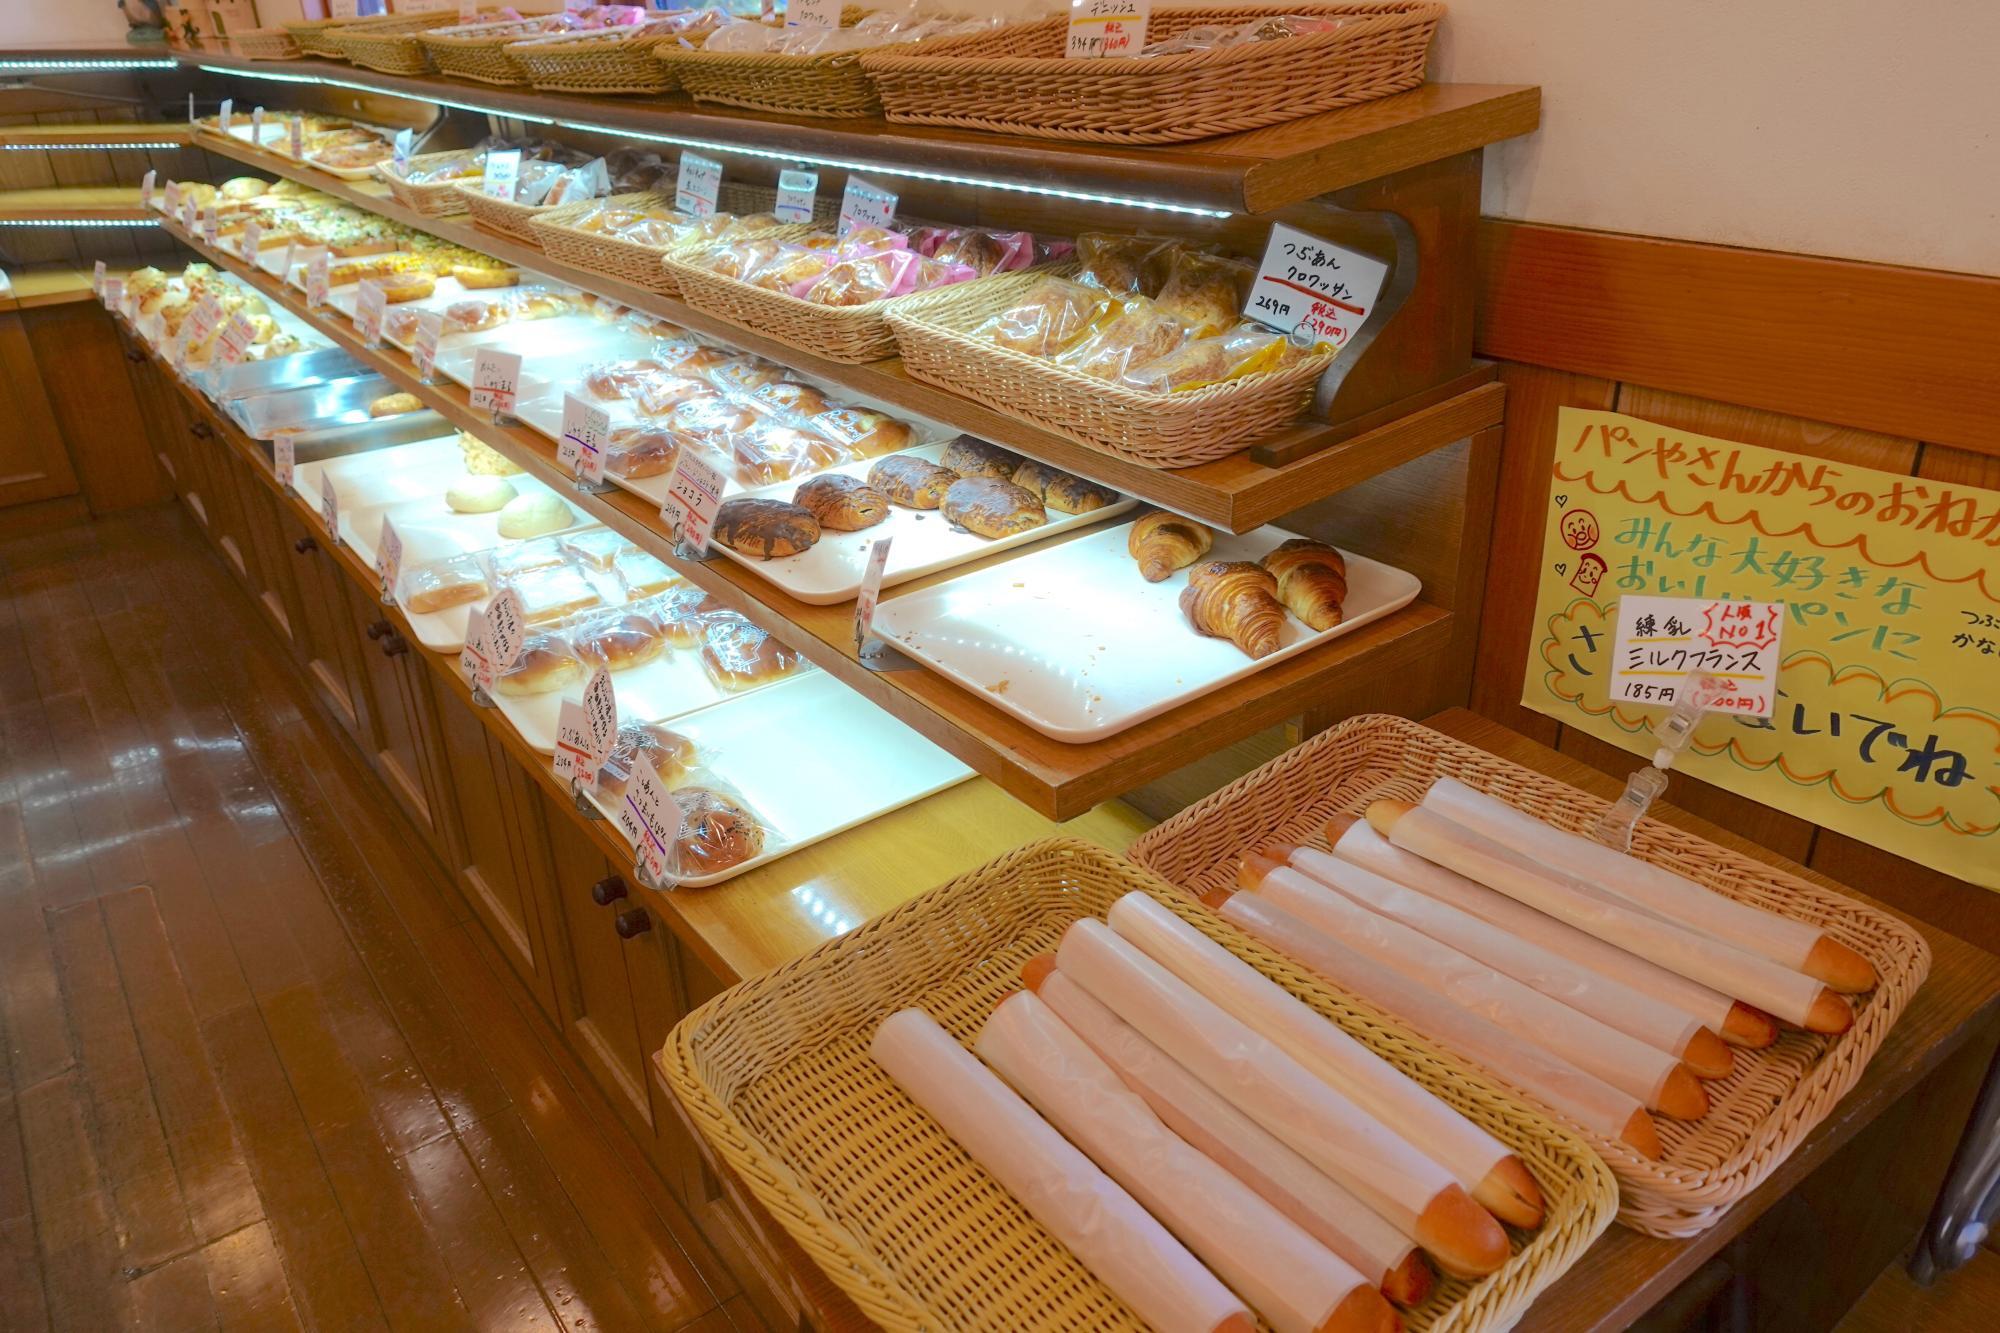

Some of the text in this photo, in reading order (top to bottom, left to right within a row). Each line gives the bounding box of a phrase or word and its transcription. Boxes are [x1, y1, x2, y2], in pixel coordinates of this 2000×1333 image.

[1284, 243, 1341, 270] つぶあん
[1287, 265, 1352, 301] クロワッサン
[1255, 295, 1290, 316] 269円
[1311, 301, 1337, 321] 税込
[1614, 517, 1928, 616] みんな大好きな
[1634, 613, 1692, 638] 練乳
[1629, 647, 1761, 671] ミルクフランス
[1625, 682, 1675, 702] 185円
